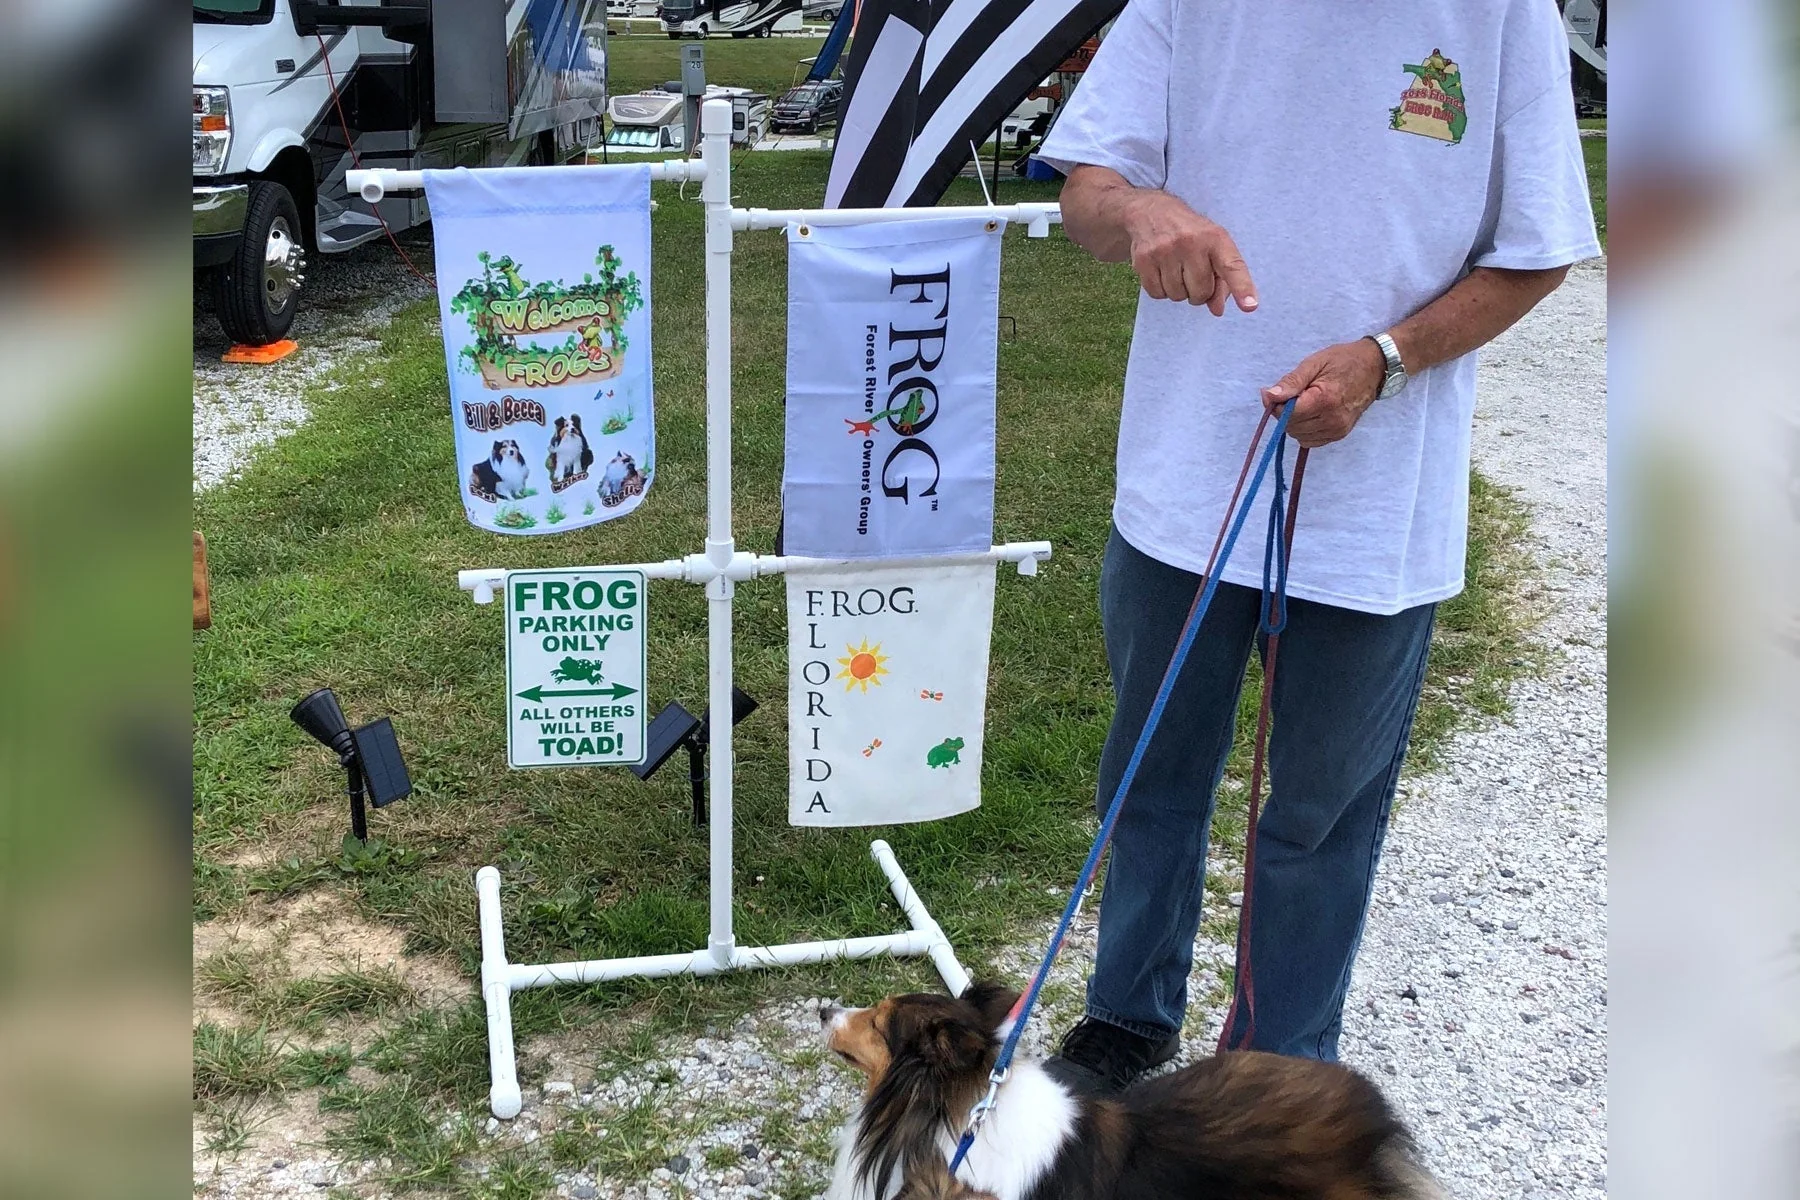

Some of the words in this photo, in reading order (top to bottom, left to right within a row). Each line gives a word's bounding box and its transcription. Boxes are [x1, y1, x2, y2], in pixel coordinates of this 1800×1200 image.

[490, 298, 611, 332] Welcome
[865, 324, 878, 372] Forest
[506, 349, 612, 386] FROGS
[882, 261, 950, 506] FROG
[864, 376, 877, 414] River
[462, 401, 487, 432] Bill
[487, 401, 502, 430] &
[501, 395, 545, 426] Becca
[551, 472, 589, 494] Walker
[861, 439, 875, 494] Owners'
[856, 496, 872, 536] Group
[515, 580, 637, 611] FROG
[519, 614, 634, 633] PARKING
[542, 634, 611, 652] ONLY
[520, 708, 555, 720] ALL
[560, 705, 635, 719] OTHERS
[541, 722, 585, 734] WILL
[591, 721, 615, 733] BE
[538, 733, 624, 756] TOAD!
